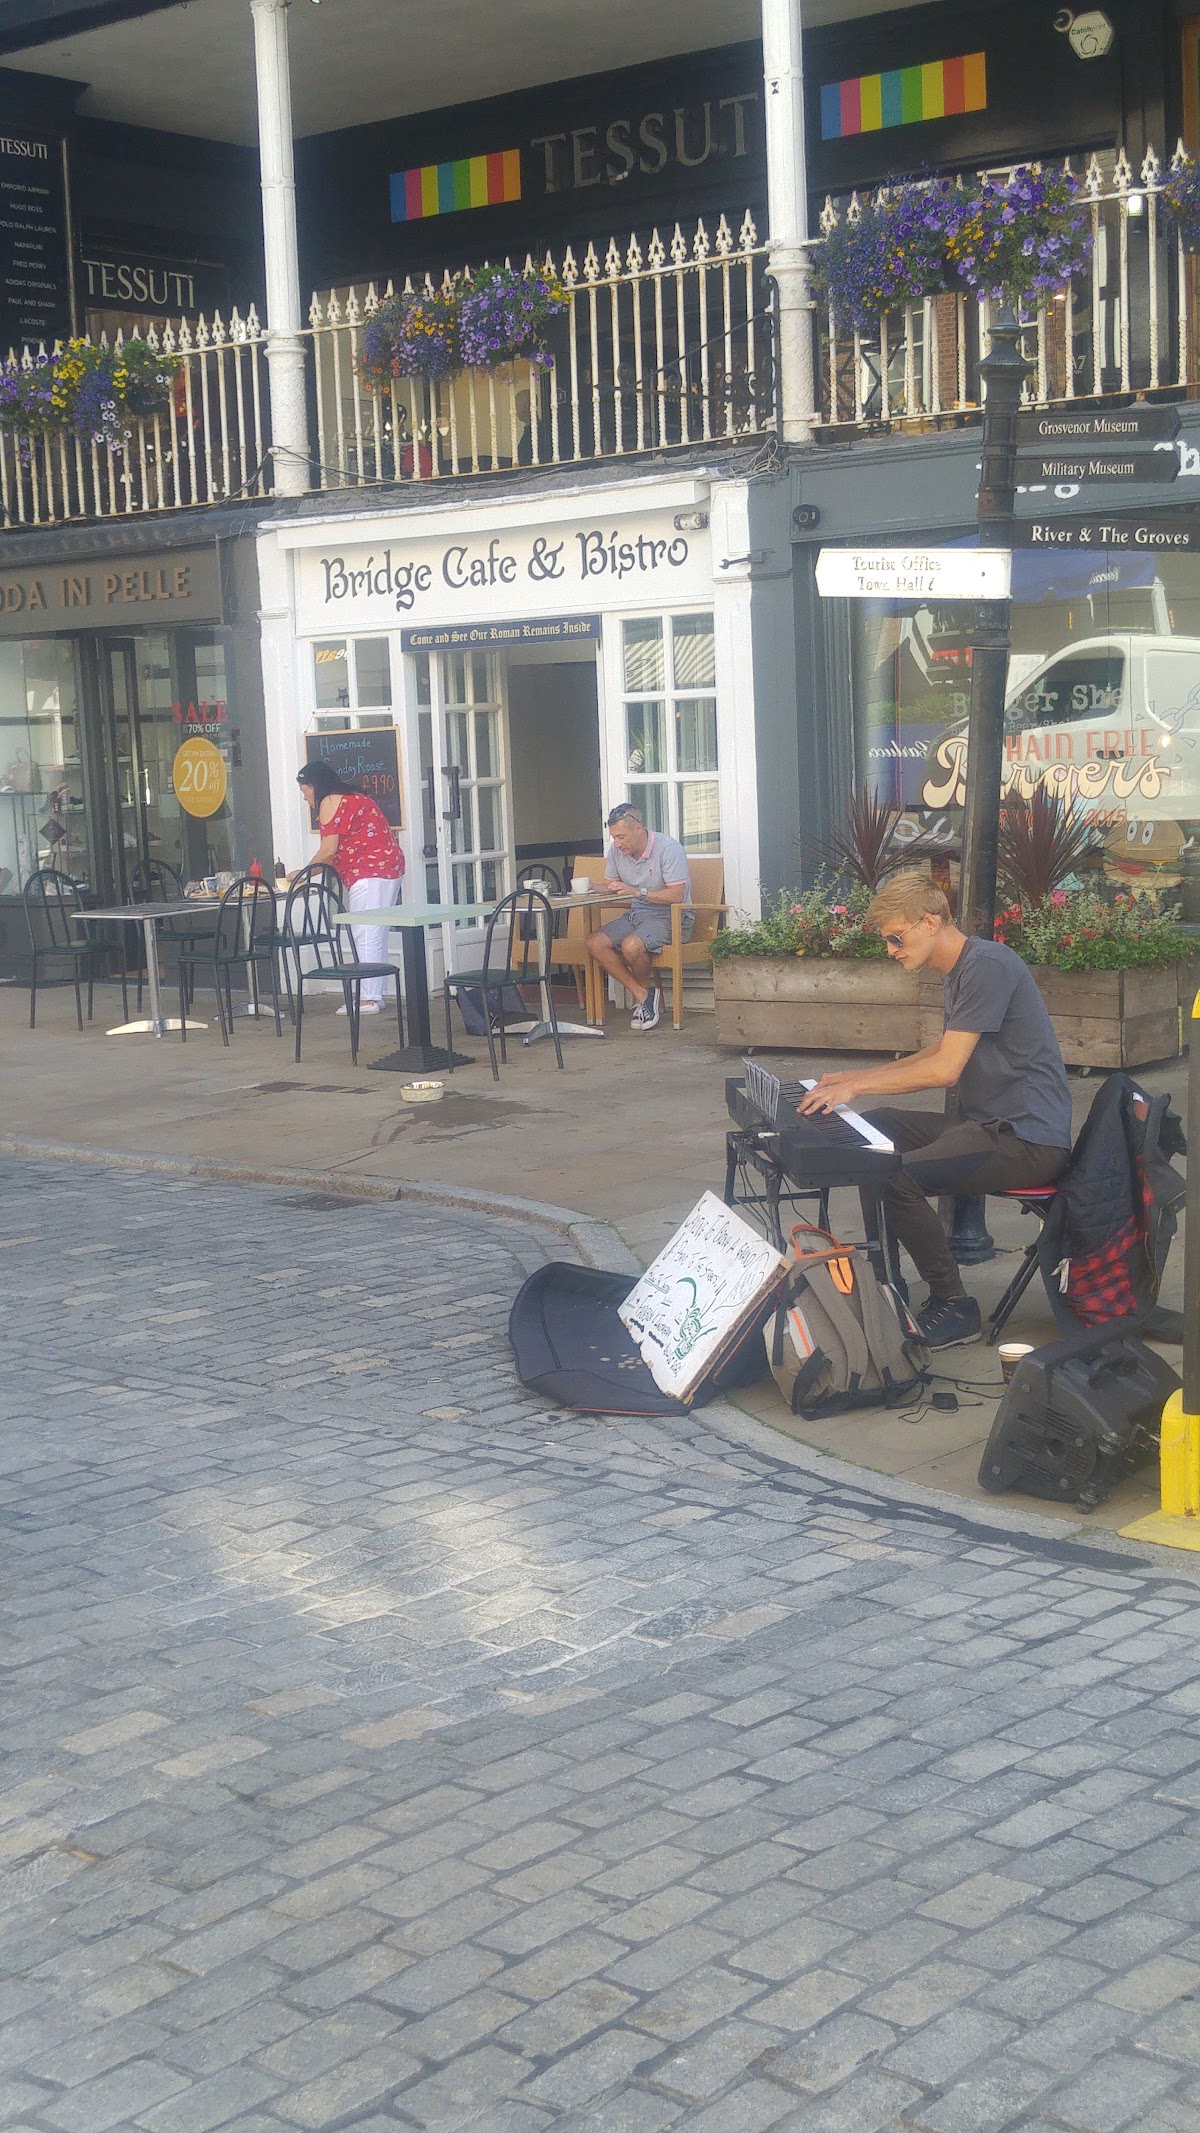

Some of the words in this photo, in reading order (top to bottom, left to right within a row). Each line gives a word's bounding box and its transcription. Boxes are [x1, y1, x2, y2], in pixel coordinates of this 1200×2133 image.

[0, 137, 48, 160] TESSUTI
[9, 202, 27, 211] HUGO
[27, 205, 43, 214] BOSS
[14, 221, 34, 231] RALPH
[34, 225, 57, 234] LAUREN
[12, 259, 28, 268] FRED
[28, 262, 46, 270] PERRY
[5, 278, 27, 287] ADIDAS
[27, 280, 57, 291] ORIGINALS
[82, 260, 194, 309] TESSUTI
[8, 297, 23, 306] PAUL
[23, 299, 36, 307] AND
[37, 300, 56, 309] SHARK
[19, 318, 46, 327] LACOSTE
[1038, 420, 1090, 436] Grosvenor
[1093, 418, 1139, 433] Museum
[1041, 462, 1086, 479] Military
[1088, 460, 1135, 475] Museum
[1031, 525, 1073, 542] River
[1078, 527, 1092, 543] &
[1099, 526, 1129, 543] The
[1134, 527, 1190, 545] Groves
[320, 548, 432, 613] Bridge
[441, 538, 518, 590] Cafe
[527, 536, 566, 582] &
[575, 530, 689, 580] Bistro
[60, 576, 90, 608] IN
[102, 567, 190, 605] PELLE
[896, 576, 924, 591] Hall
[409, 633, 433, 646] Come
[434, 631, 450, 644] and
[450, 629, 468, 642] See
[469, 628, 488, 641] Our
[489, 626, 521, 640] Roman
[521, 623, 561, 638] Remains
[562, 620, 591, 635] Inside
[171, 699, 228, 724] SALE
[204, 723, 221, 734] OFF
[320, 737, 372, 756] Homemade
[1005, 731, 1073, 763] HAIN
[1086, 728, 1155, 759] FREE
[357, 755, 386, 774] Roast
